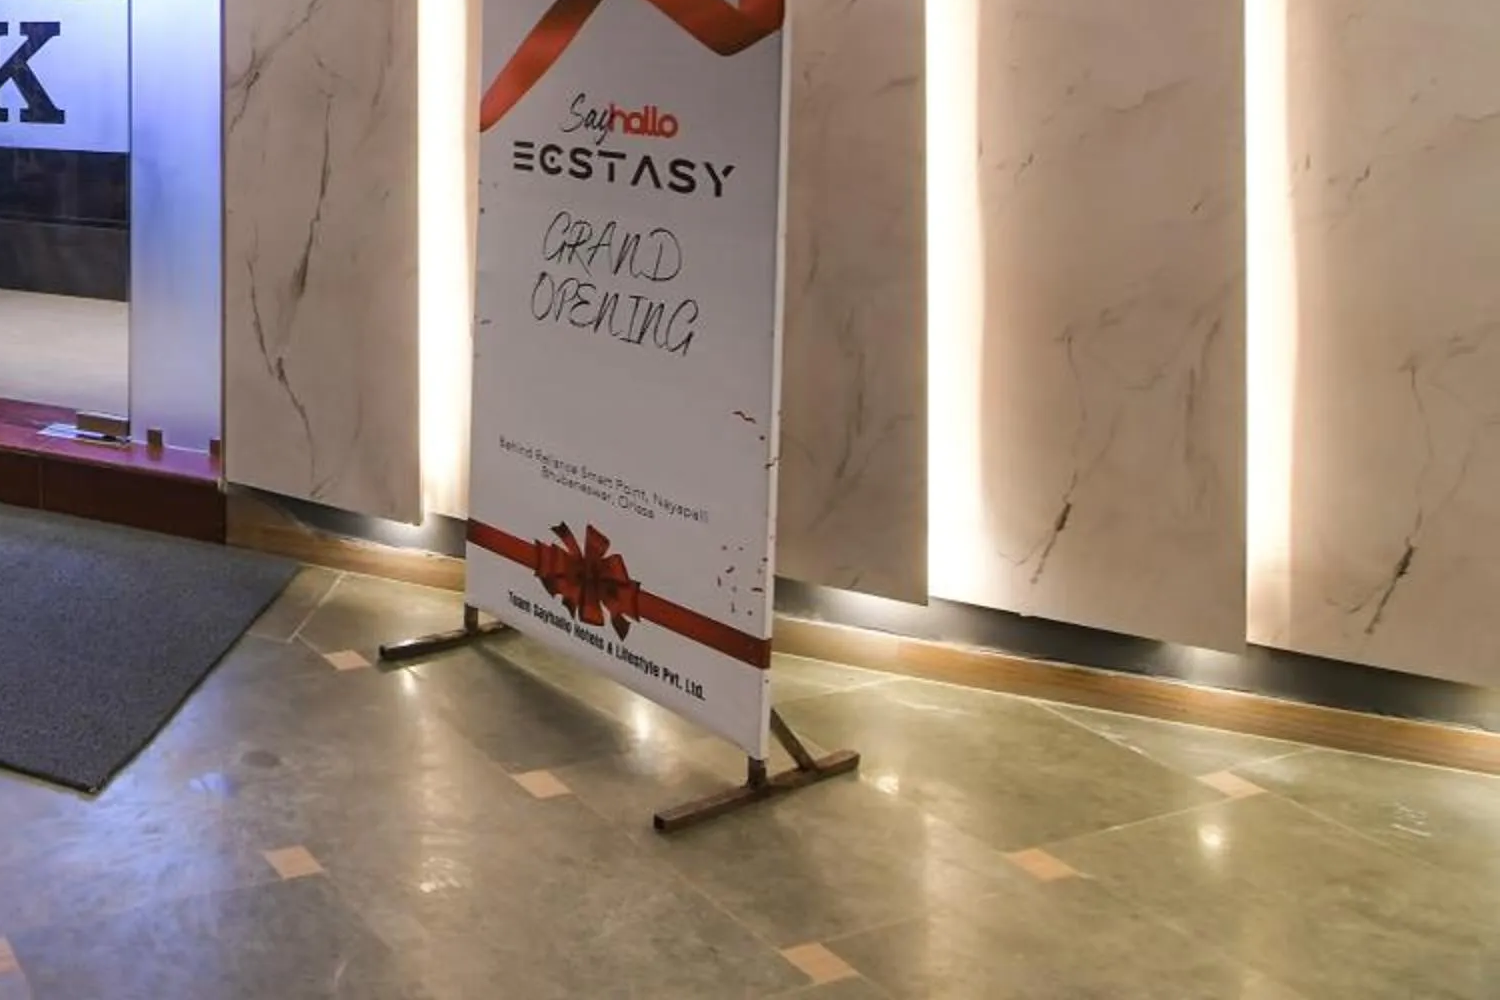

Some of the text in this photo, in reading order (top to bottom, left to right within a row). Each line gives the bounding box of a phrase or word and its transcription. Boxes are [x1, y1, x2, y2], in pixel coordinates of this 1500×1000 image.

[513, 141, 735, 198] ECSTASY
[543, 211, 682, 282] GRAND
[531, 271, 699, 356] OPENING
[508, 591, 531, 613] Team
